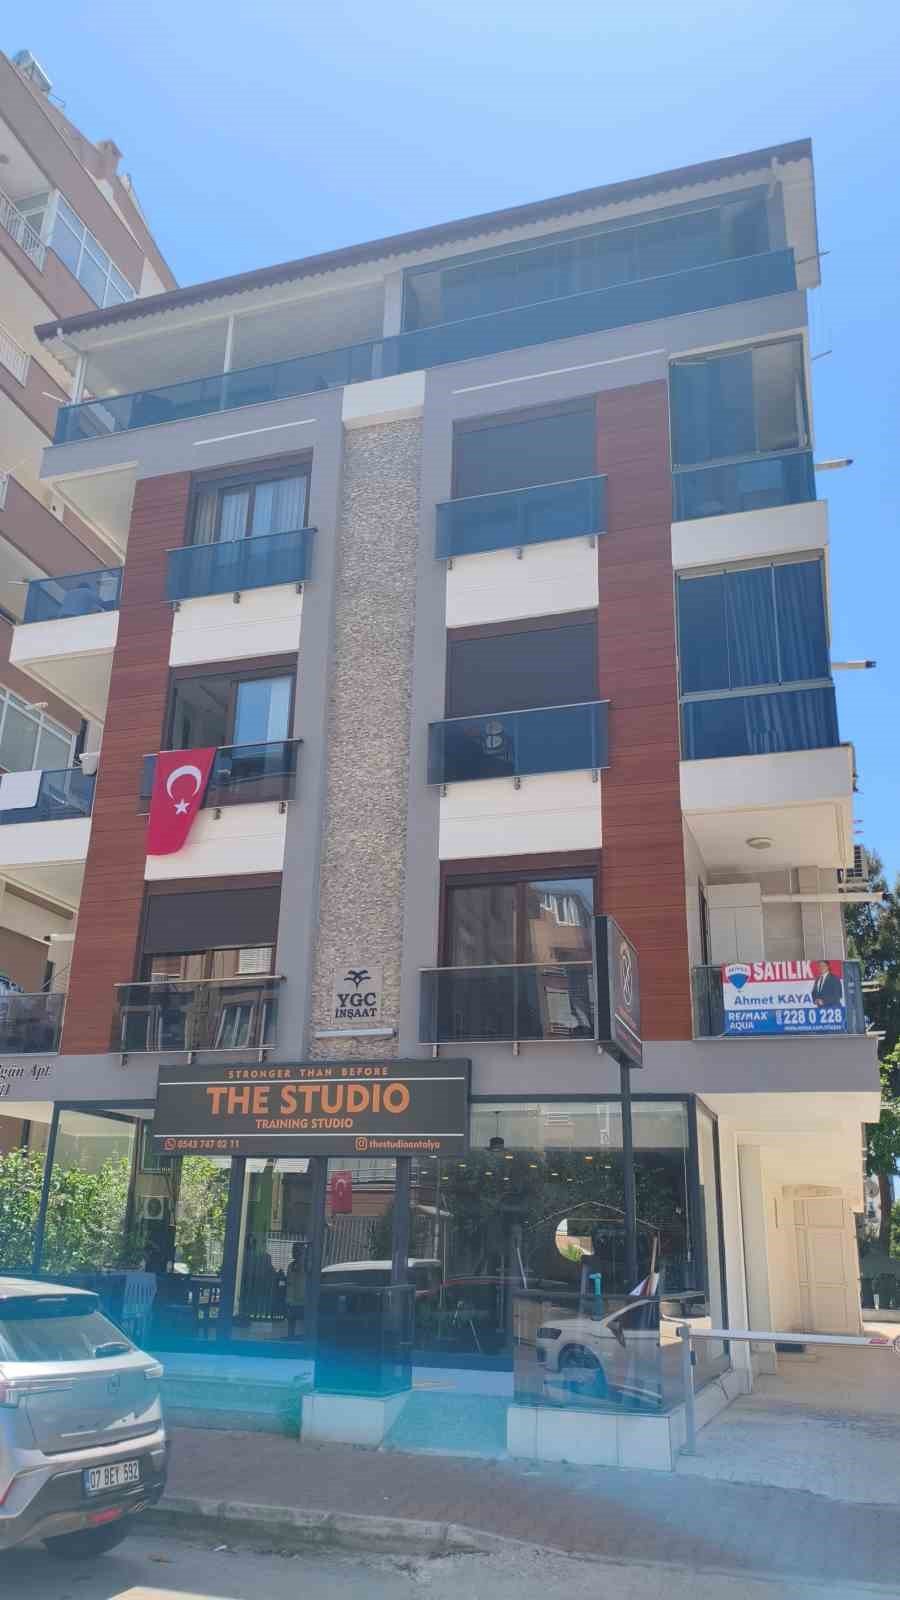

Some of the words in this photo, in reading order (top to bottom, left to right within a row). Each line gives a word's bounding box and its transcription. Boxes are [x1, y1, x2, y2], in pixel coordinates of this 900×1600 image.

[752, 960, 814, 981] SATILIK
[337, 992, 377, 1008] YGC
[734, 993, 774, 1006] Ahmet
[778, 991, 813, 1004] KAYA
[728, 1010, 769, 1022] RE/MAX
[783, 1009, 806, 1025] 228
[808, 1009, 817, 1024] 0
[820, 1008, 843, 1024] 228
[729, 1021, 755, 1032] AQUA
[228, 1069, 291, 1080] STRONGER
[299, 1067, 332, 1078] THAN
[341, 1066, 389, 1077] BEFORE
[207, 1086, 270, 1116] THE
[280, 1082, 410, 1116] STUDIO
[256, 1119, 309, 1130] TRAINING
[311, 1118, 353, 1129] STUDIO
[90, 1471, 101, 1489] 07
